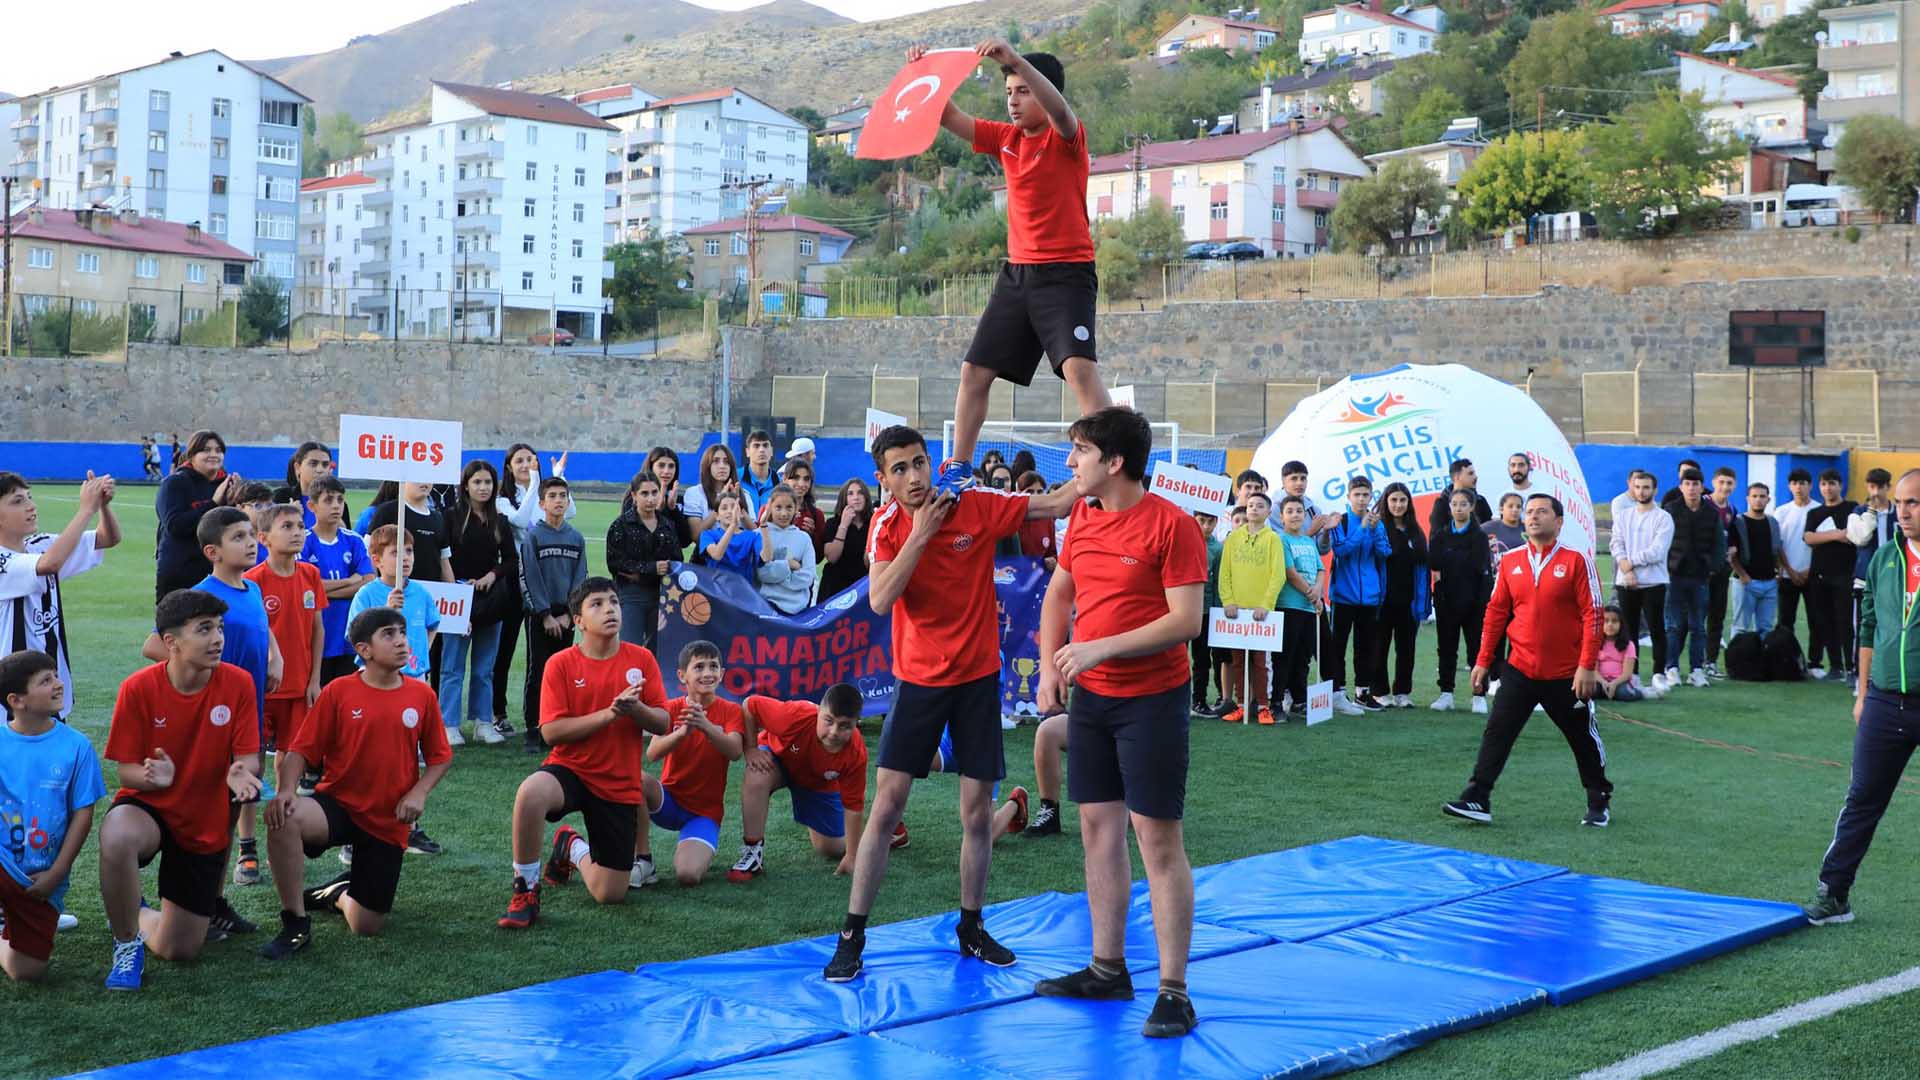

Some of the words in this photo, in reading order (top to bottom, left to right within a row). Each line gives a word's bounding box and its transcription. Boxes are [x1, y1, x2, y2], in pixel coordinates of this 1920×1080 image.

[358, 433, 445, 466] Güreş
[1342, 425, 1433, 465] BİTLİS
[1156, 474, 1224, 503] Basketbol
[727, 617, 870, 664] AMATÖR
[1215, 620, 1276, 637] Muaythai
[789, 643, 894, 697] HAFTA
